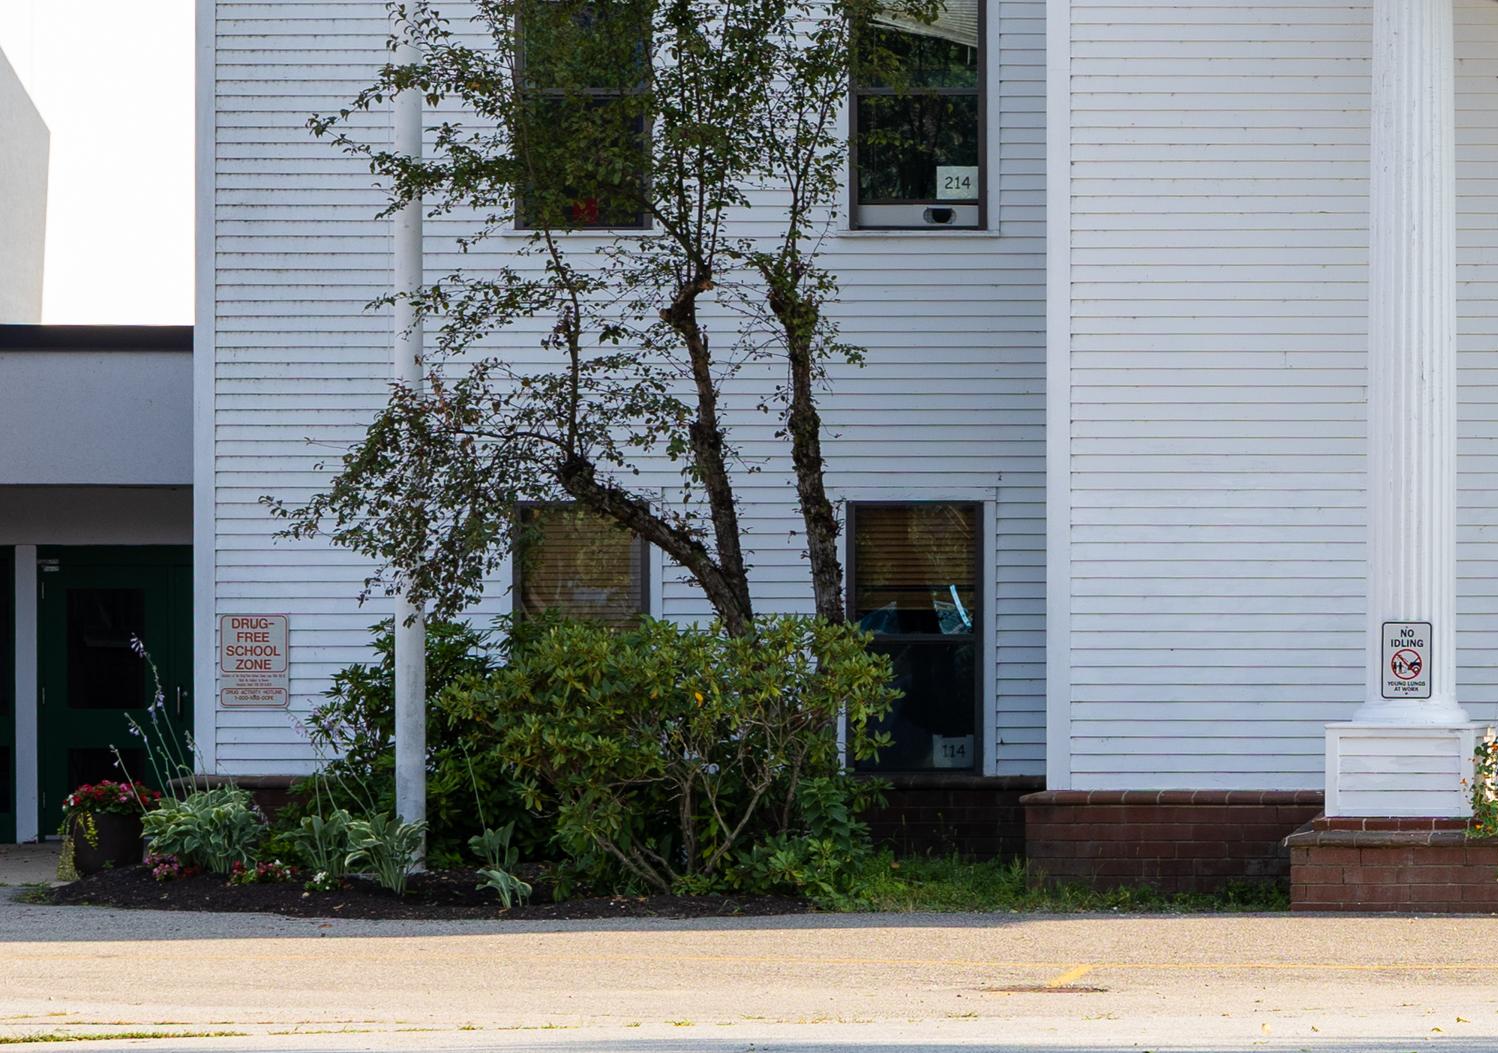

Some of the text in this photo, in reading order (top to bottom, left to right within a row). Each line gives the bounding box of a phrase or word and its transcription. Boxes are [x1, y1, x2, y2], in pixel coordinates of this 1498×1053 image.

[944, 176, 971, 190] 214
[231, 618, 275, 629] DRUG-
[236, 632, 270, 643] FREE
[1400, 629, 1414, 637] NO
[1390, 639, 1424, 647] IDLING
[226, 645, 281, 657] SCHOOL
[235, 659, 272, 670] ZONE
[942, 744, 966, 758] 114
